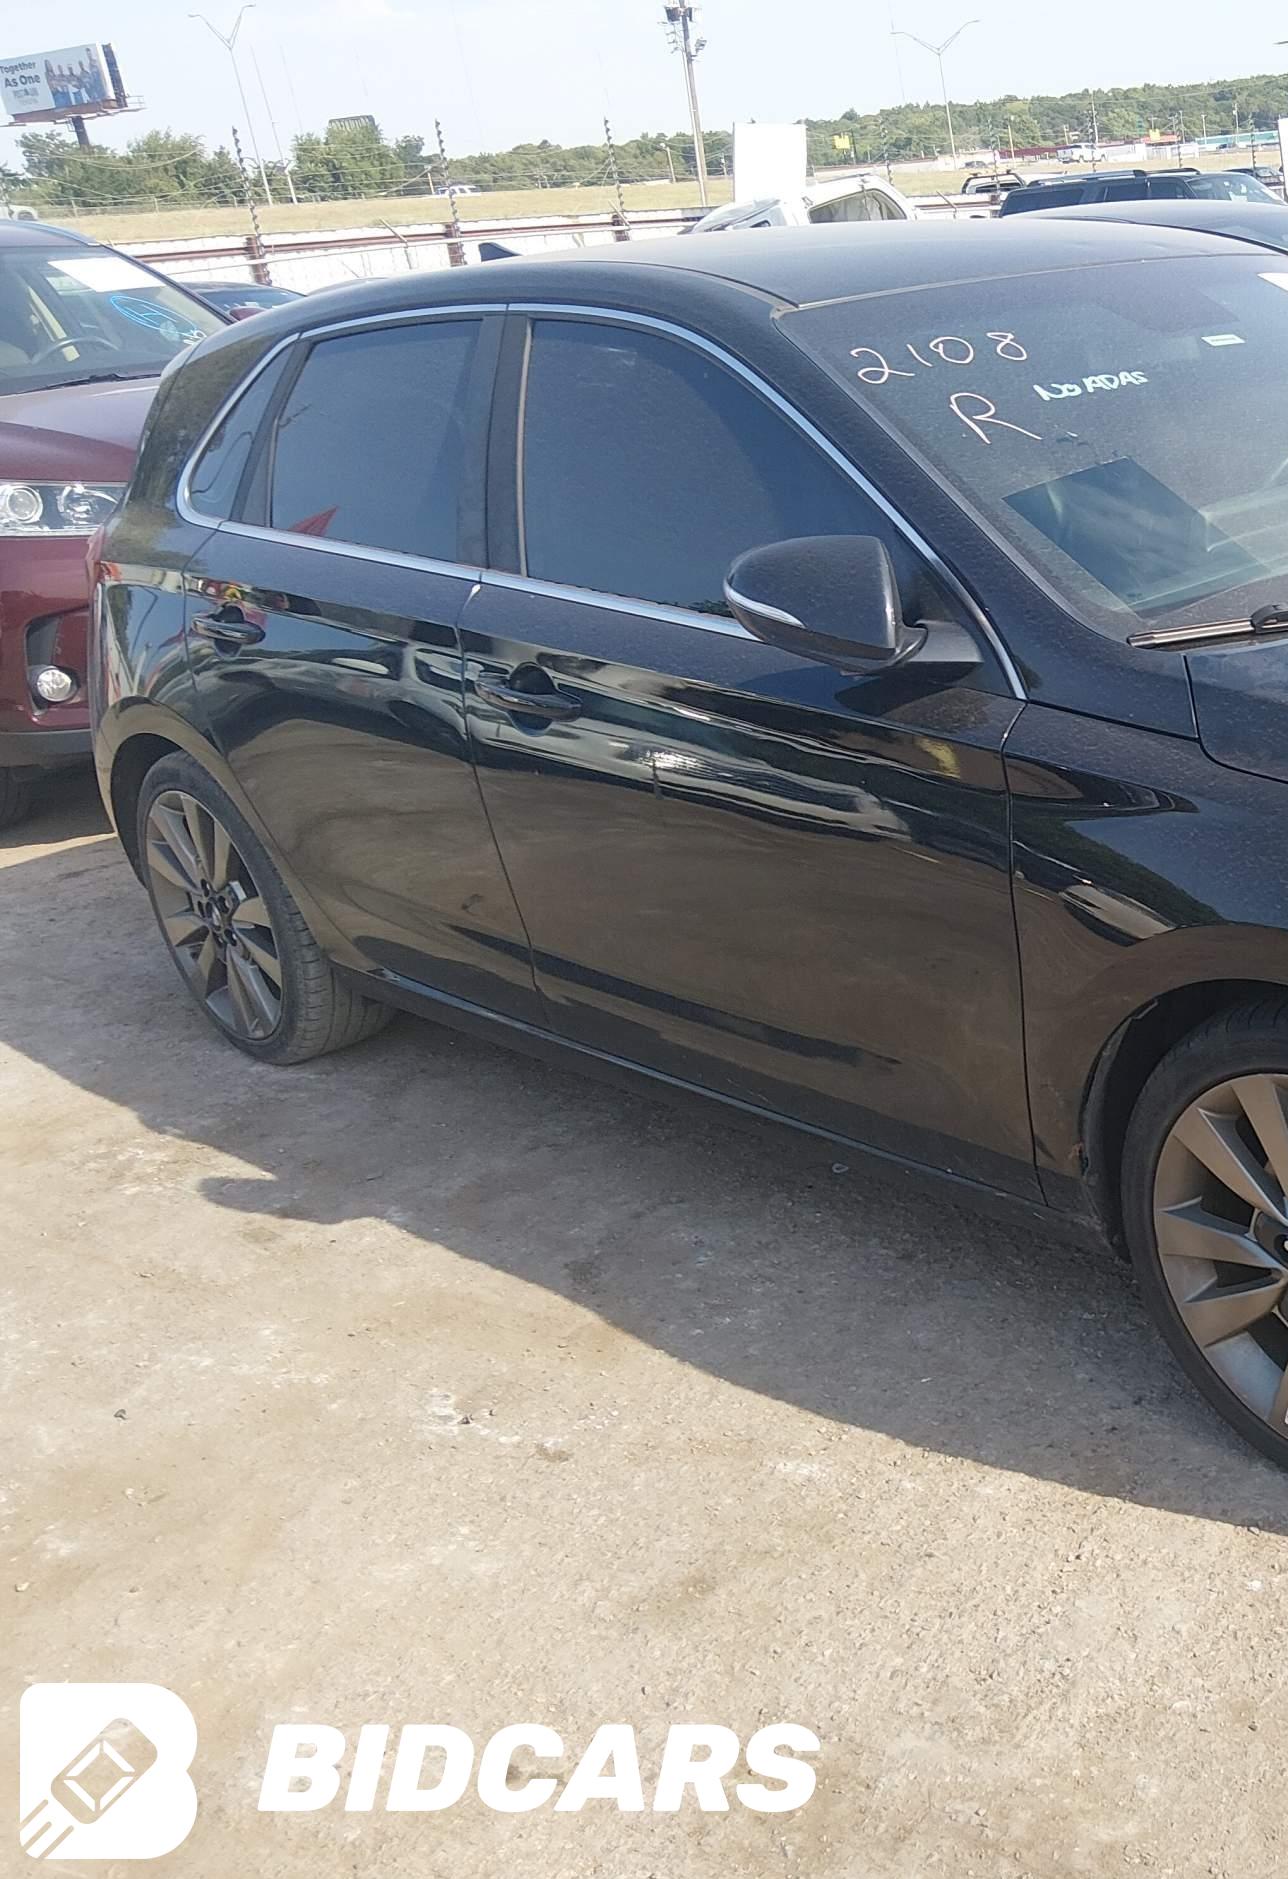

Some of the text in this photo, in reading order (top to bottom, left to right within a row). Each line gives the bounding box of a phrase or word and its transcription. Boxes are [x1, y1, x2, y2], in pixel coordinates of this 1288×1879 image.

[0, 61, 36, 75] Together
[5, 75, 41, 88] As One
[850, 331, 1028, 384] 2108
[1032, 371, 1149, 401] NO ADAS
[949, 392, 1042, 444] R
